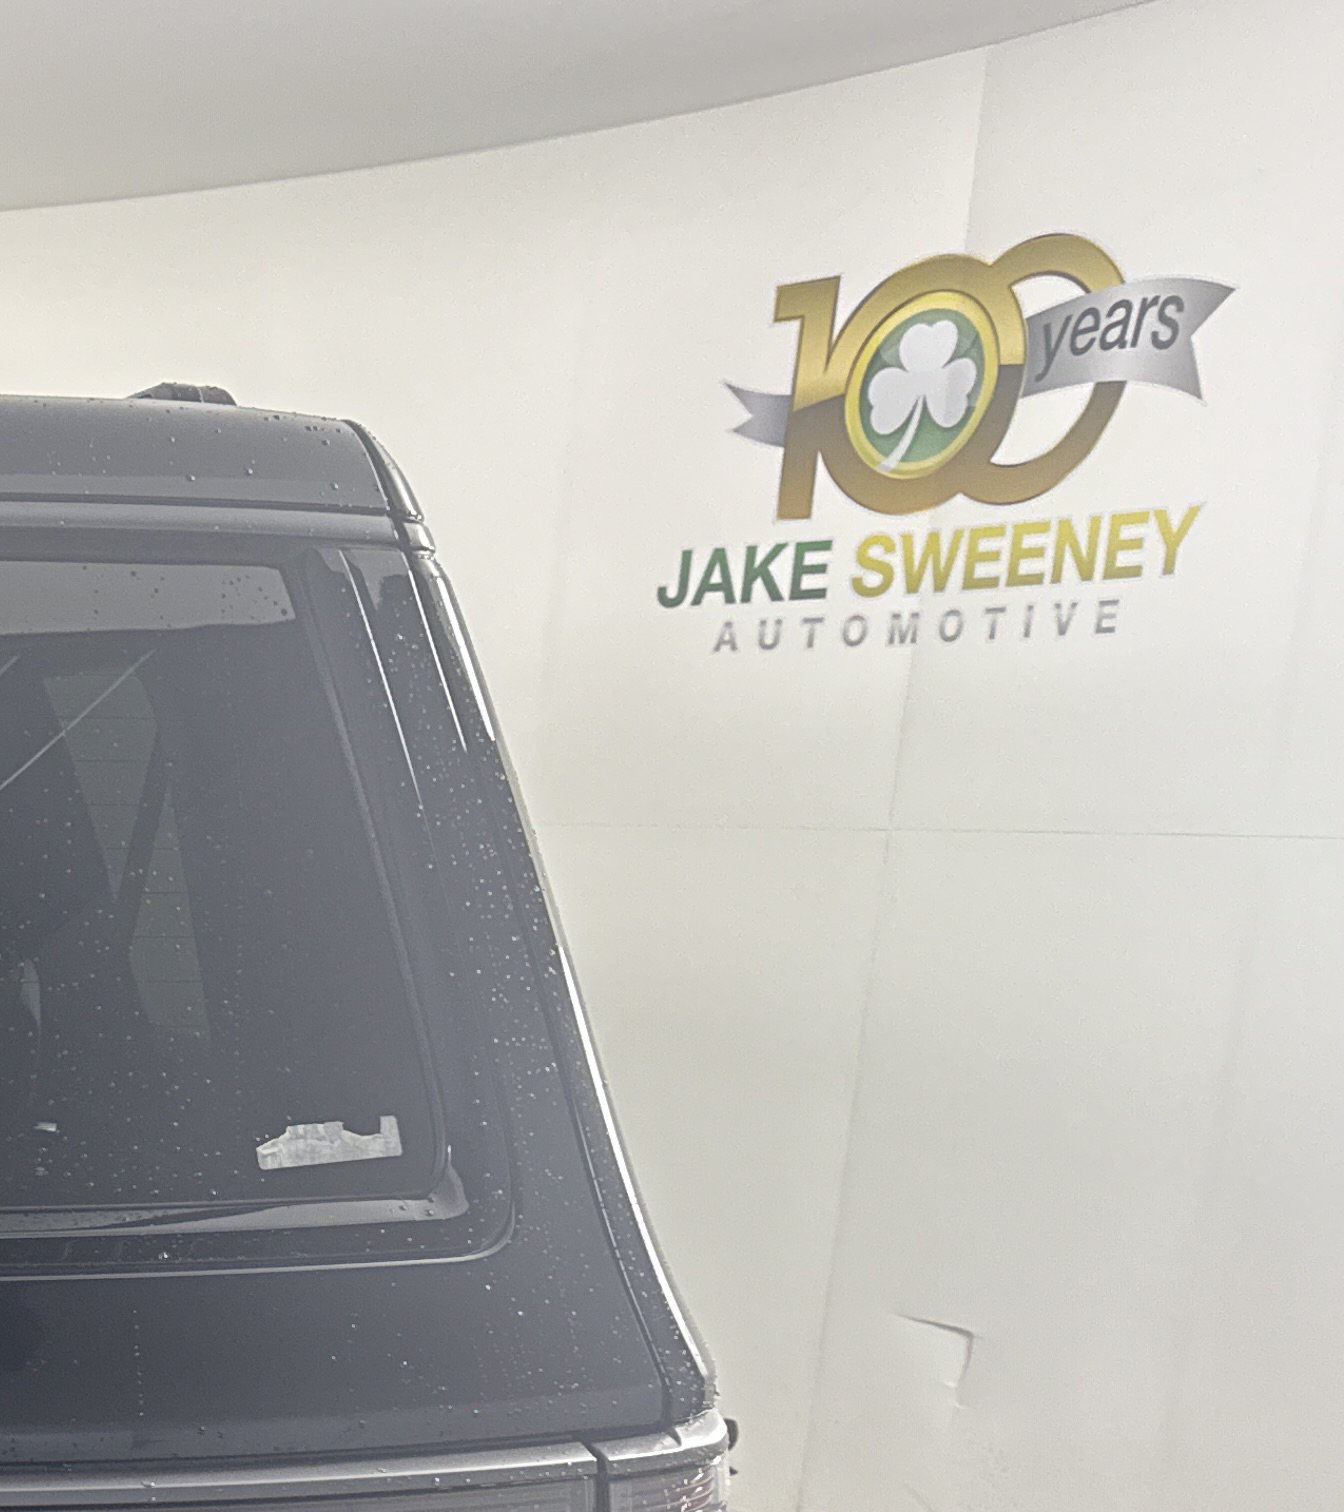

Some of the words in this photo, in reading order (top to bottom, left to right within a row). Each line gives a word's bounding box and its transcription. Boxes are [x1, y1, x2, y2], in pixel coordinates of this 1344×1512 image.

[1036, 294, 1185, 380] years
[657, 541, 832, 608] JAKE
[852, 505, 1204, 598] SWEENEY
[713, 600, 1120, 653] AUTOMOTIVE
